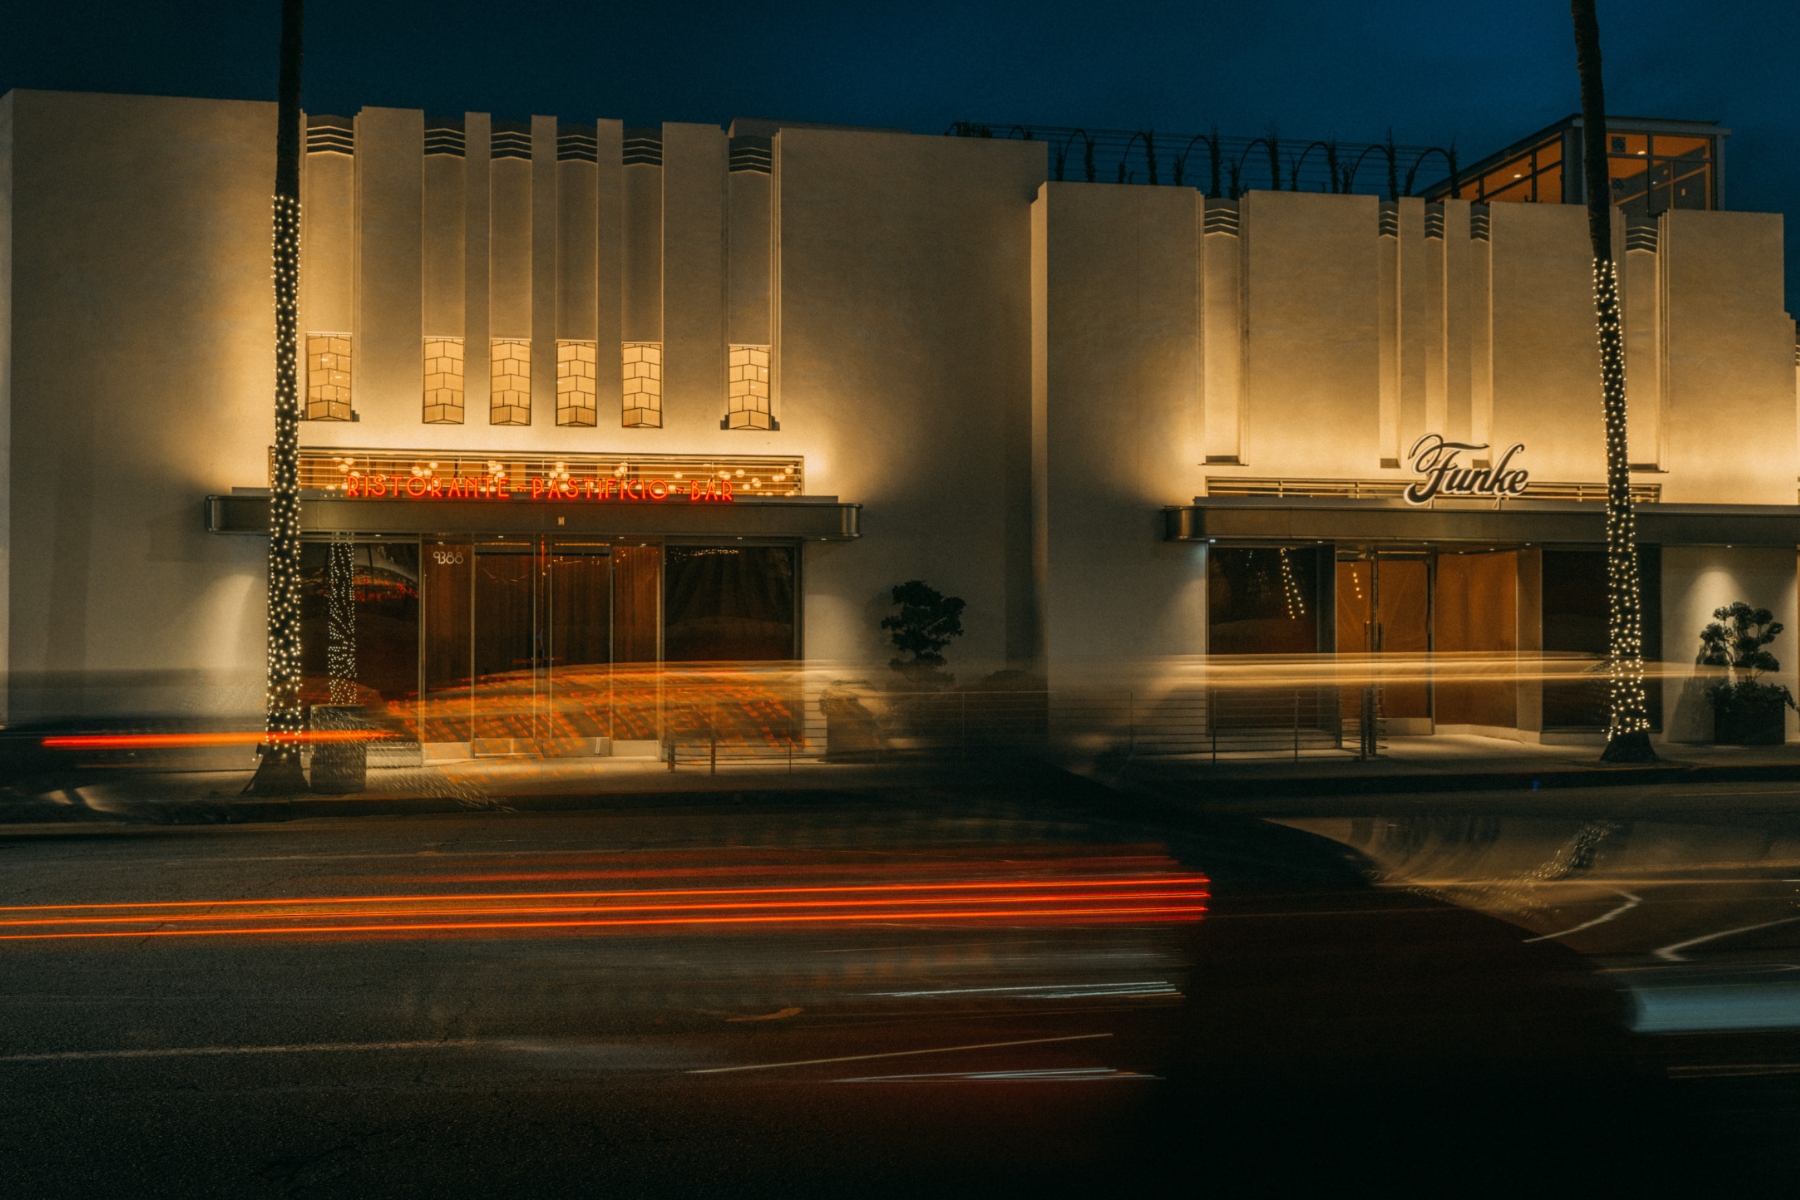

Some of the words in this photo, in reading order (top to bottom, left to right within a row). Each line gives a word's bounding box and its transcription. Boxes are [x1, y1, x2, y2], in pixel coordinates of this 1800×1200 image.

[1404, 432, 1529, 505] Funke
[347, 475, 510, 498] RISTORANTE
[531, 478, 669, 500] PASTIFICIO
[690, 479, 733, 501] BAR
[433, 551, 464, 564] 9388
